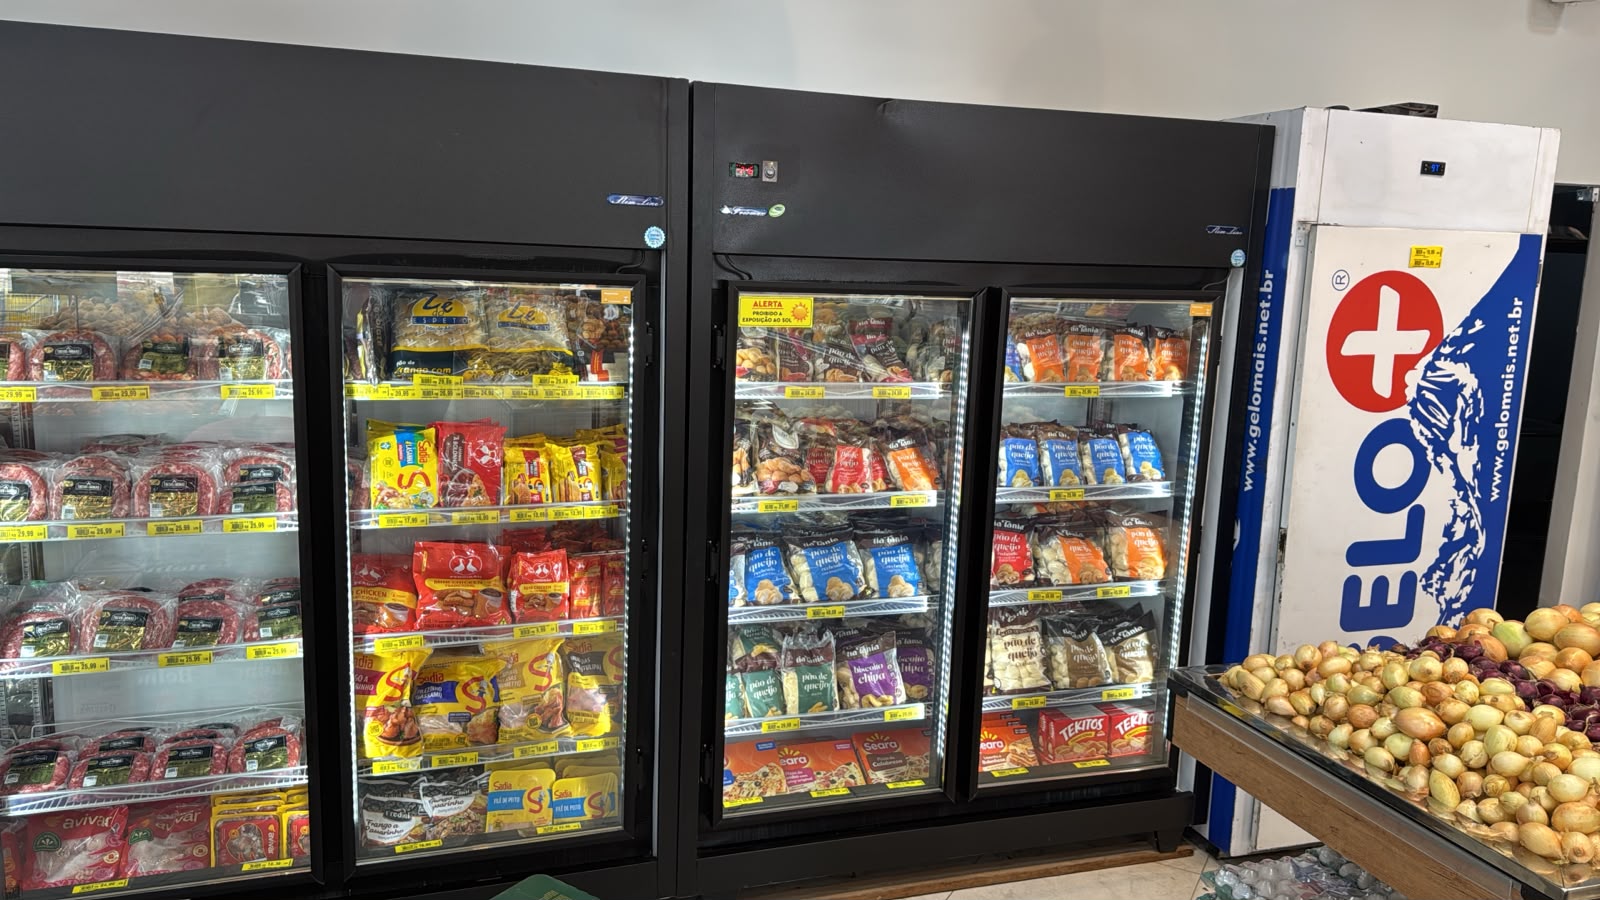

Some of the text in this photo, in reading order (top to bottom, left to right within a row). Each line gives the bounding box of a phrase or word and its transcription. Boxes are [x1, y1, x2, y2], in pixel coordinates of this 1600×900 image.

[752, 300, 783, 308] ALERTA
[412, 317, 468, 325] ESPETO
[1243, 269, 1275, 492] www.gelomais.net.br
[1490, 297, 1523, 502] www.gelomais.net.br
[418, 440, 431, 464] Sadia
[1339, 417, 1432, 651] ELO
[994, 543, 1021, 552] queijo
[815, 554, 845, 568] queijo
[356, 589, 387, 598] CHICKEN
[1004, 635, 1036, 650] pão de
[1008, 648, 1038, 661] queijo
[900, 662, 925, 674] hipa
[858, 673, 886, 685] chipa
[1058, 718, 1105, 741] TEKITOS
[863, 741, 899, 751] Seara
[779, 755, 807, 766] eara
[493, 781, 513, 790] Sadia
[553, 789, 573, 799] Sadia
[62, 815, 113, 830] avivar
[366, 818, 393, 829] Frango
